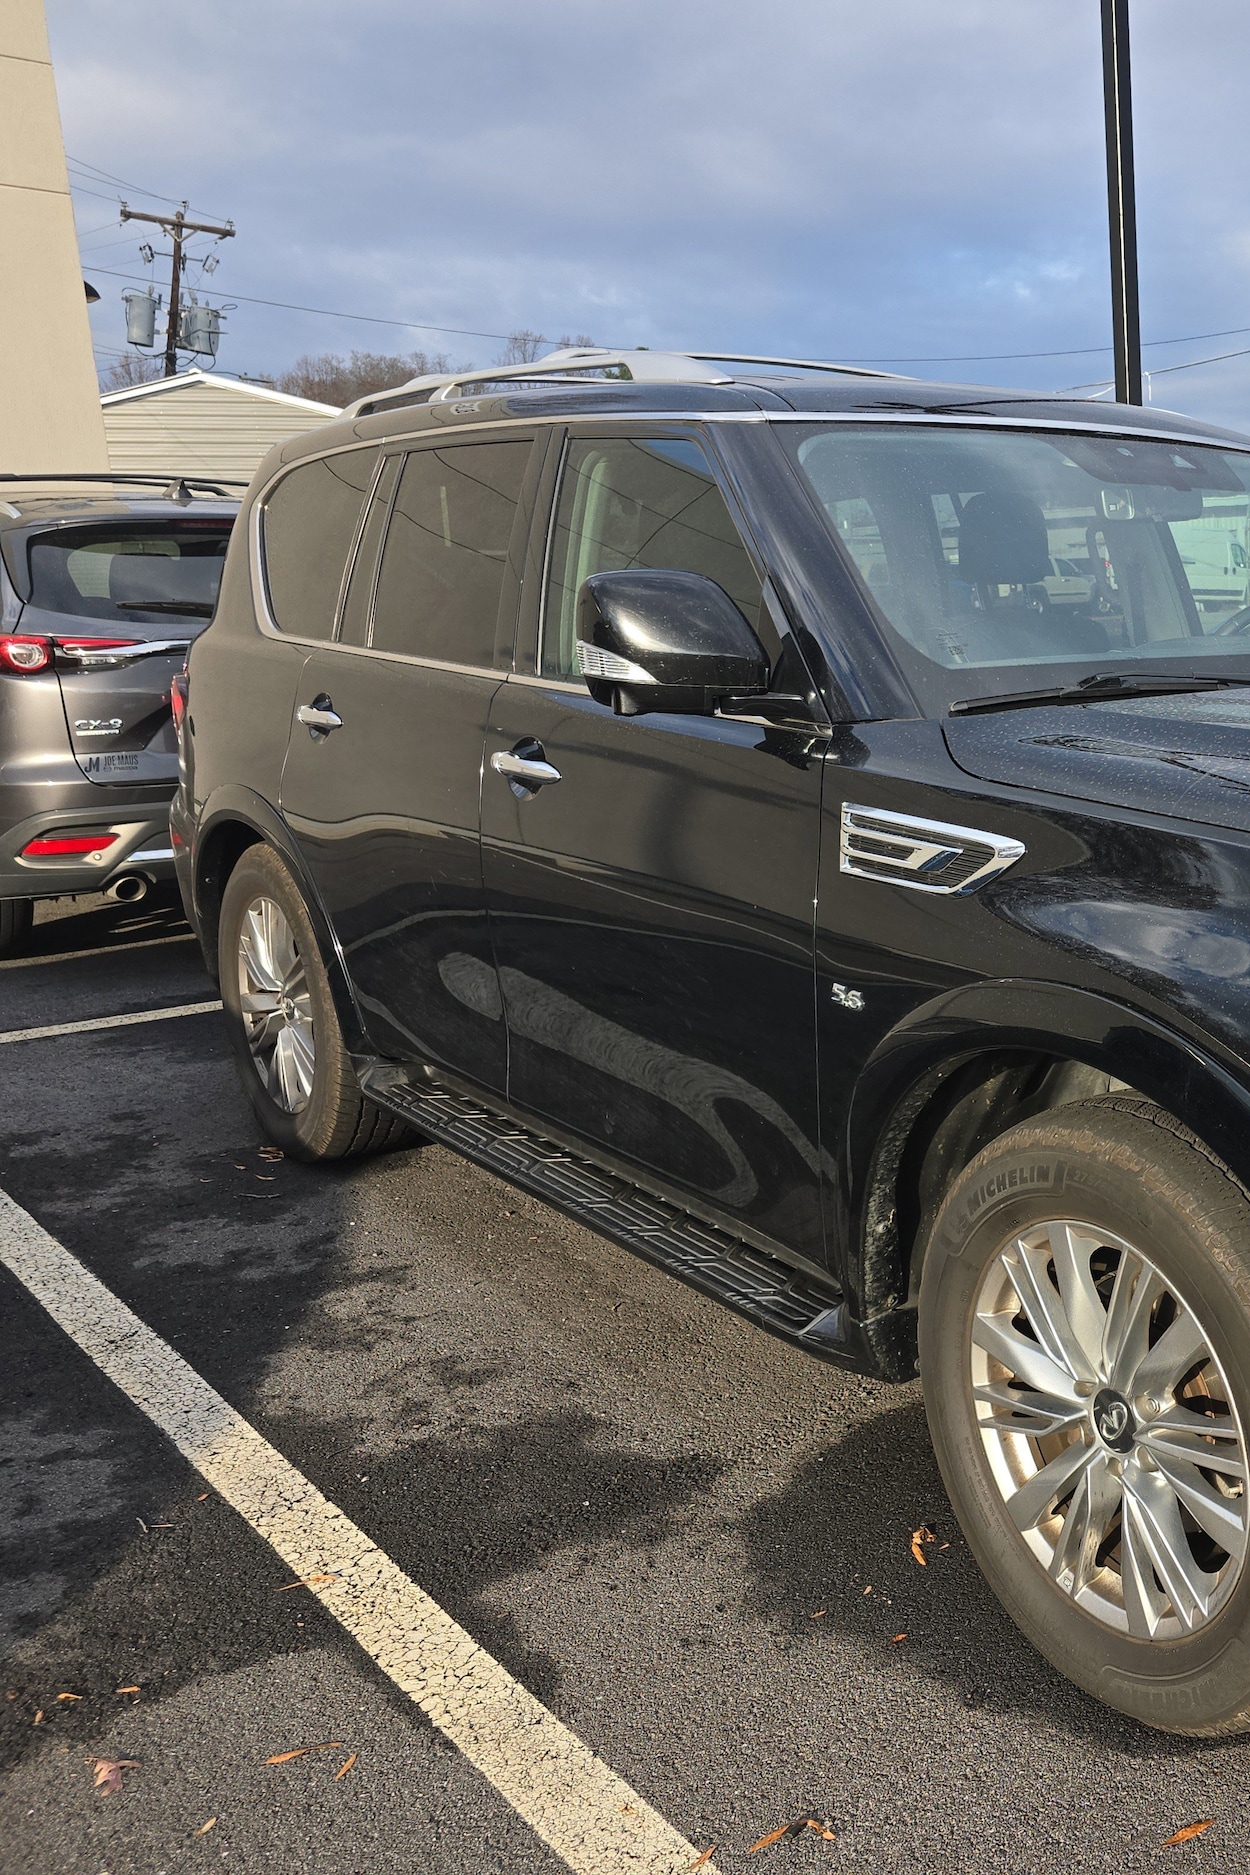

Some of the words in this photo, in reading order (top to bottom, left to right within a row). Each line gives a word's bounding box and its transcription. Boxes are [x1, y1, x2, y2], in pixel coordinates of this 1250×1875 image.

[74, 718, 123, 729] CX-9
[84, 756, 100, 773] JM
[104, 755, 117, 767] JOE
[117, 754, 139, 766] MAUS
[966, 1164, 1051, 1216] MICHELIN
